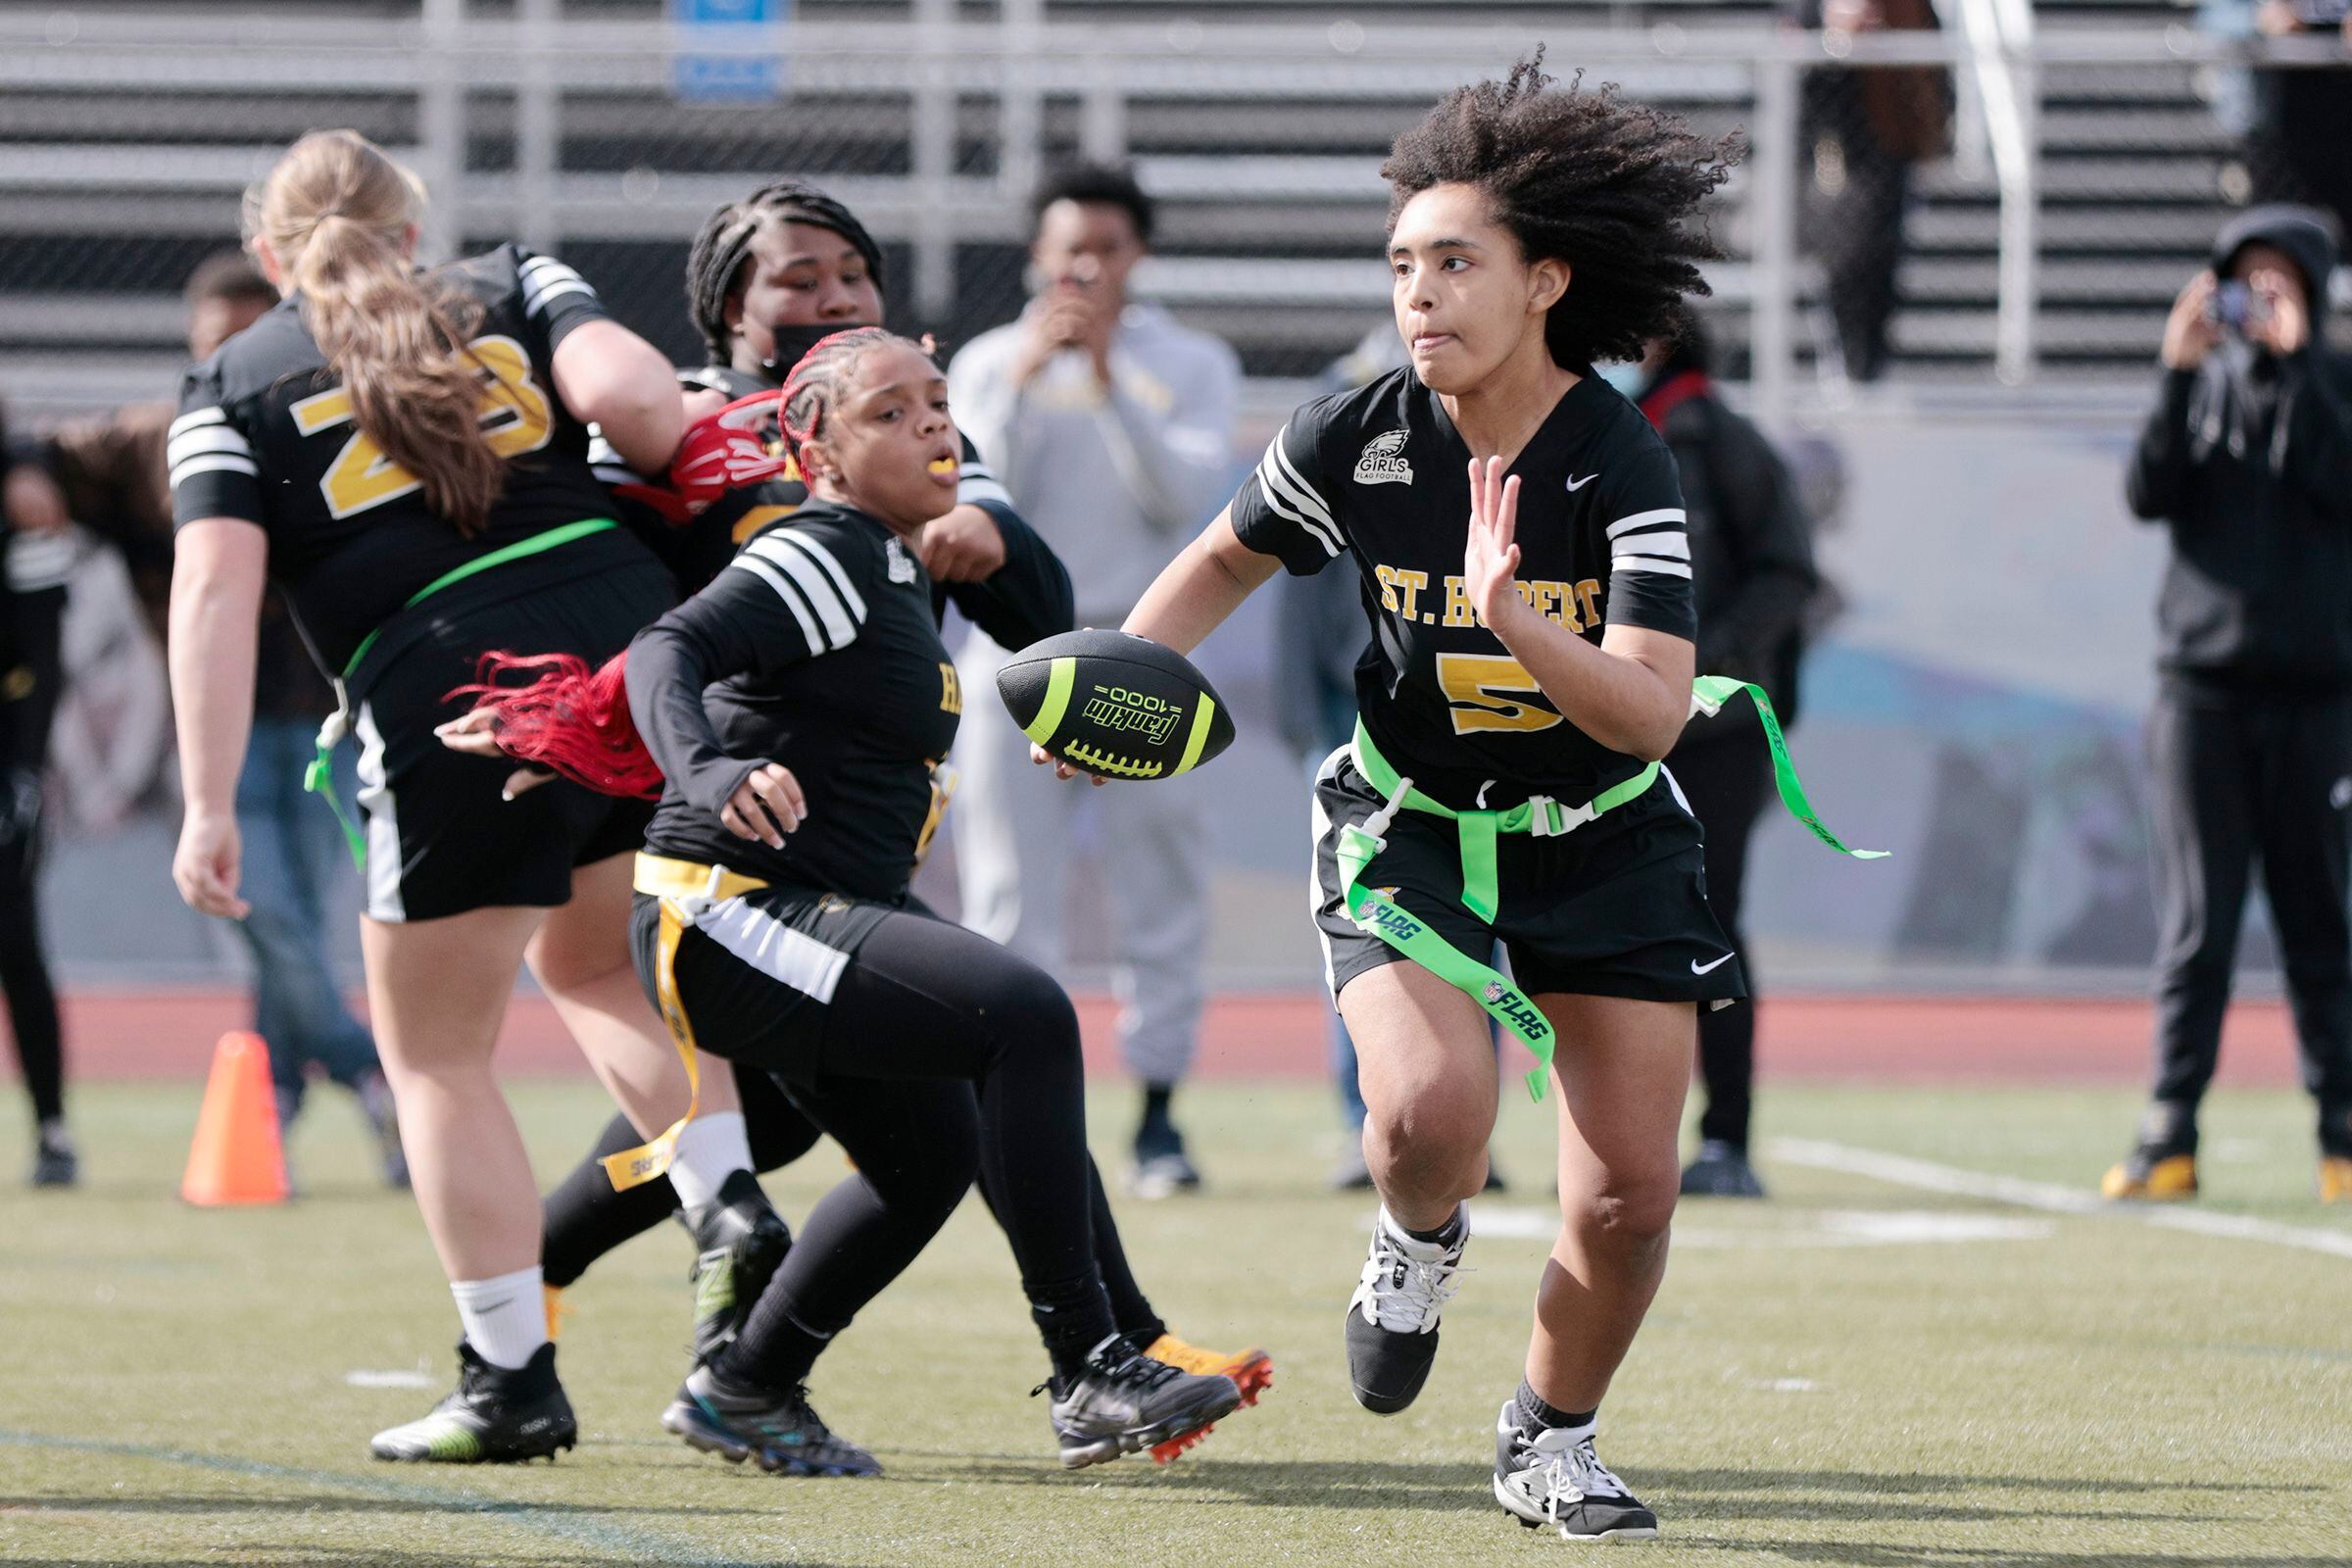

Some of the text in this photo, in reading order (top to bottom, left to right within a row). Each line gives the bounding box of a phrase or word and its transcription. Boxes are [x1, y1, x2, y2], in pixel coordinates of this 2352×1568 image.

[1359, 459, 1406, 473] GIRLS
[1375, 472, 1411, 481] FOOTBALL
[1442, 573, 1602, 634] HERT
[1435, 652, 1565, 736] 5
[1361, 904, 1422, 941] FLAG
[1488, 991, 1549, 1041] FLAG
